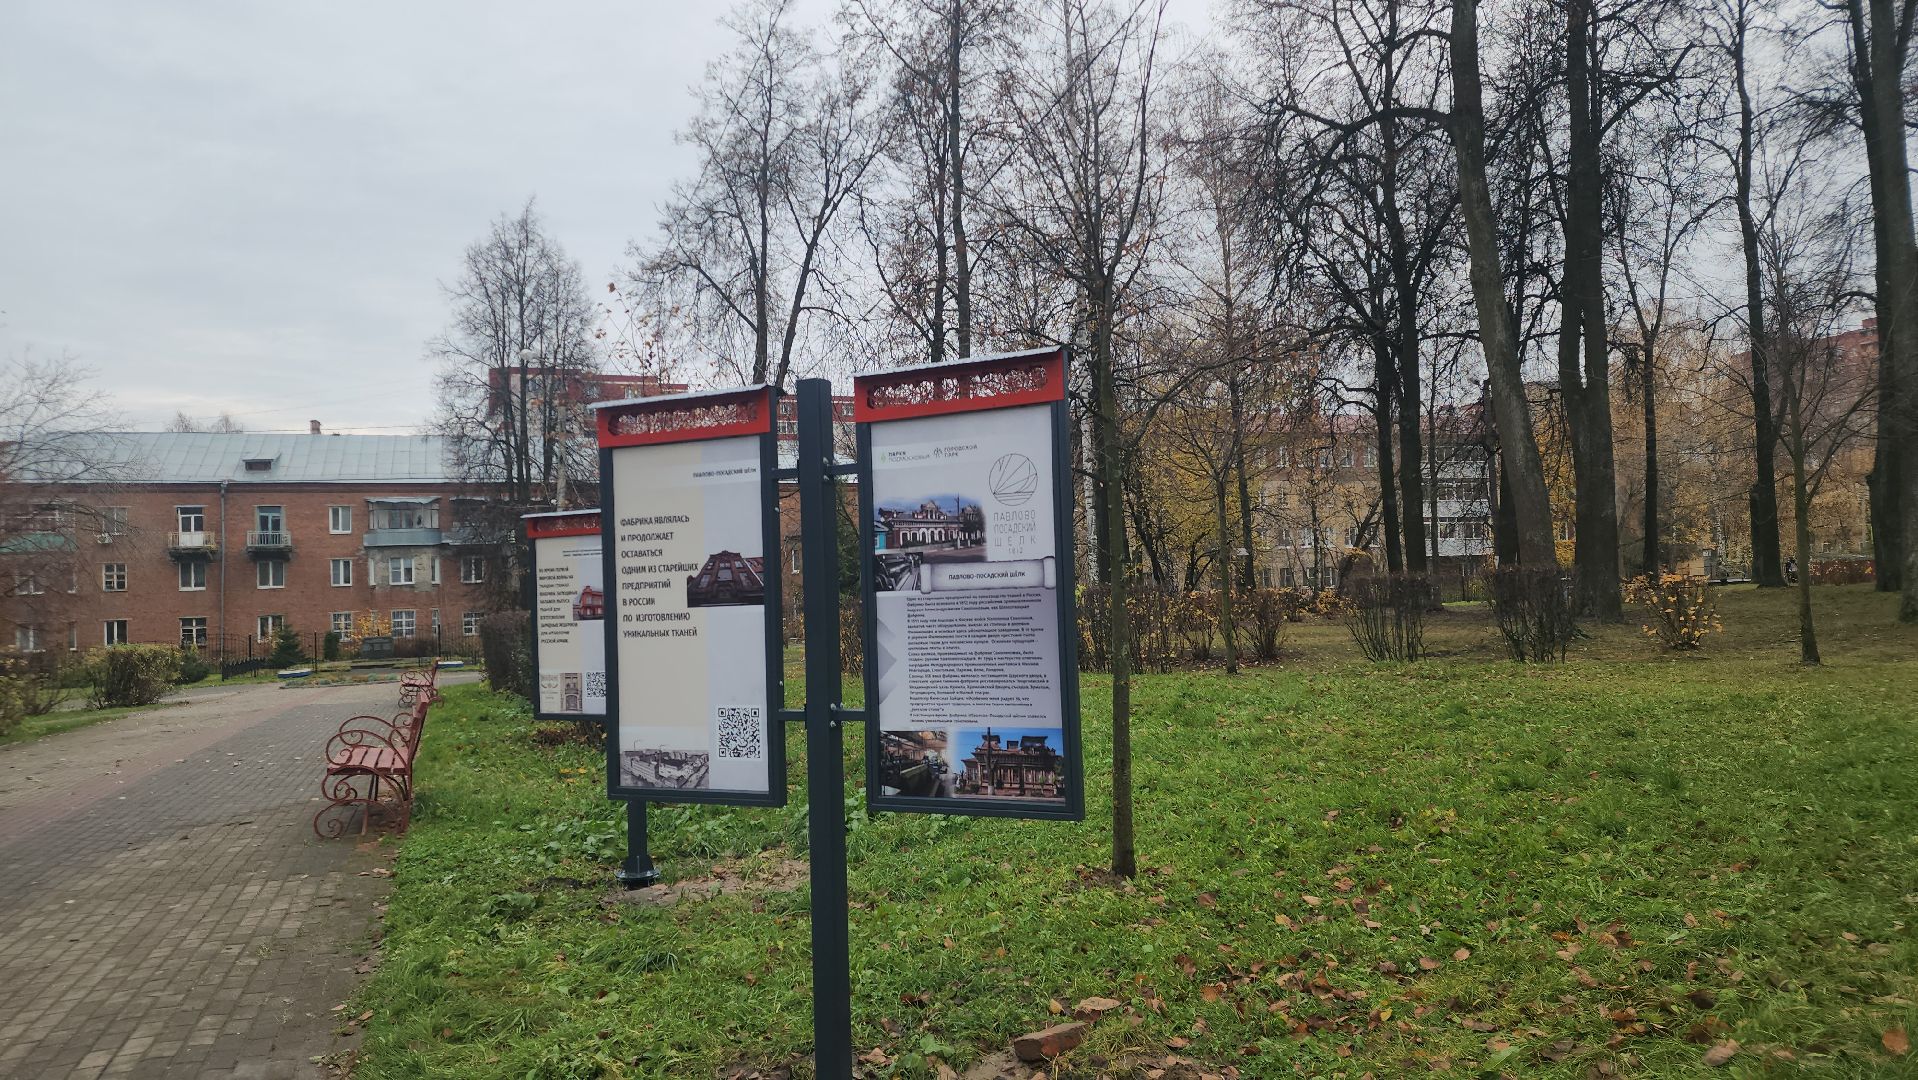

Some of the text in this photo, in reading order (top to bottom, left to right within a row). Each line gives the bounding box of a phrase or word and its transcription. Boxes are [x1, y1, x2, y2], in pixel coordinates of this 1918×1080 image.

[993, 509, 1036, 521] ПАВЛОВО
[620, 515, 690, 527] ФАБРИКА ЯВЛЯЛАСЬ
[994, 520, 1036, 534] ПОСАДСКИЙ
[627, 532, 674, 541] ПРОДОЛЖАЕТ
[621, 549, 663, 559] ОСТАВАТЬСЯ
[621, 562, 699, 575] ОДНИМ ИЗ СТАРЕЙШИХ
[948, 571, 1009, 580] ПАВЛОВО-ПОСАДСКИЙ
[622, 579, 671, 591] ПРЕДПРИЯТИЙ
[628, 598, 656, 606] РОССИИ
[623, 612, 690, 622] ПО ИЗГОТОВЛЕНИЮ
[623, 627, 698, 638] УНИКАЛЬНЫХ ТКАНЕЙ
